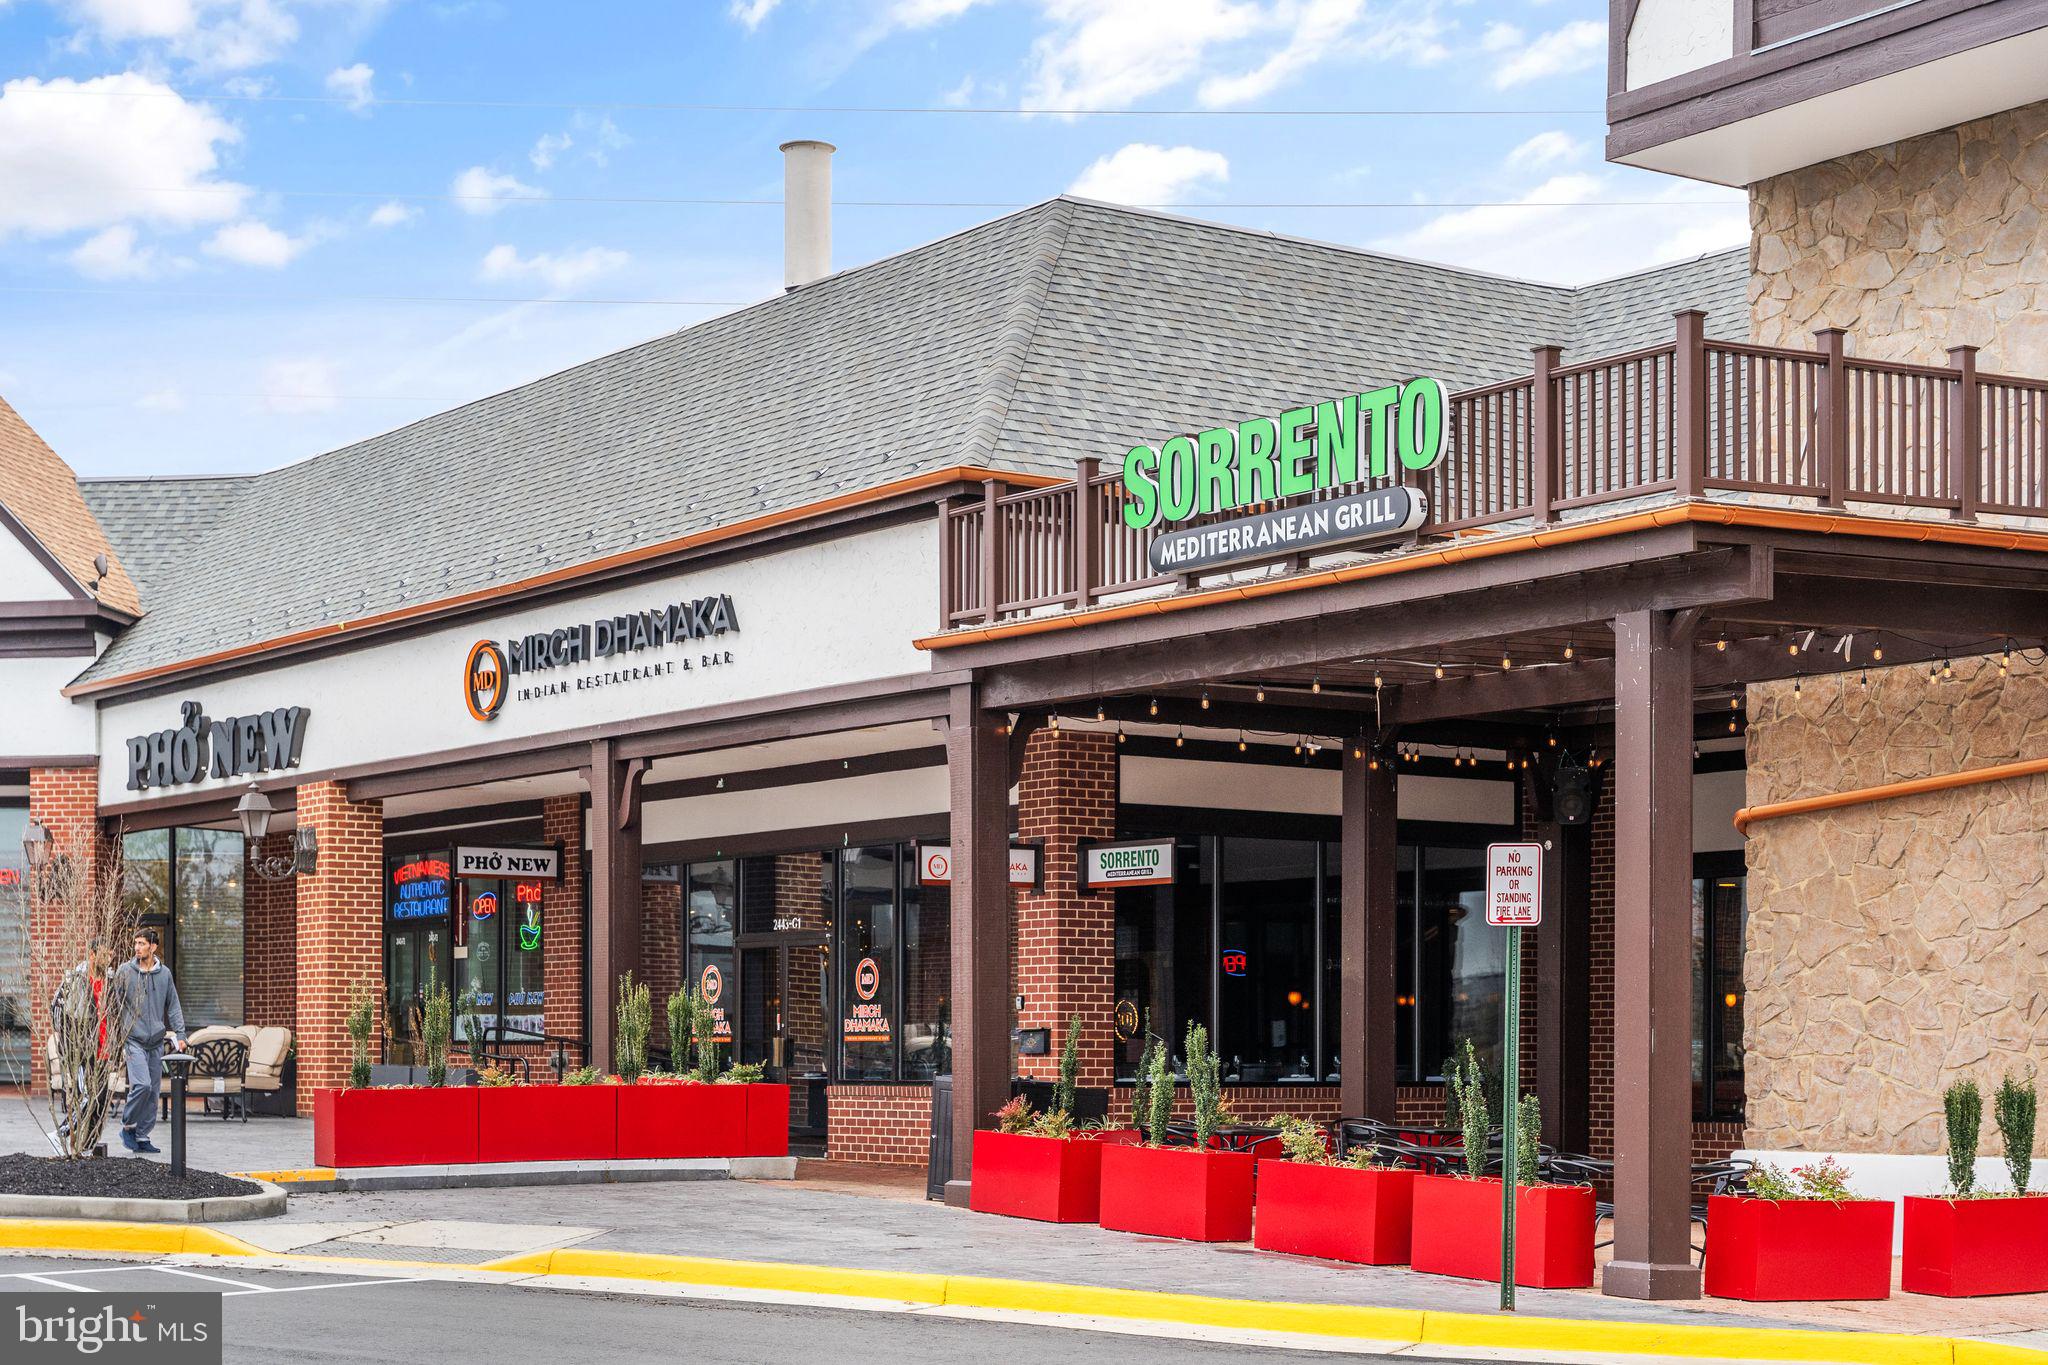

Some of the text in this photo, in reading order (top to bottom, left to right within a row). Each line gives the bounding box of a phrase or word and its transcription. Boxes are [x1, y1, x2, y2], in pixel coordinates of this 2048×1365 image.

[1123, 376, 1449, 530] SORRENTO
[1160, 495, 1397, 566] MEDITERRANEAN GRILL
[508, 593, 740, 675] MIRCH DHAMAKA
[473, 669, 495, 691] MD
[518, 651, 734, 702] INDIAN RESTAURANT & BAR
[210, 706, 311, 779] NEW
[507, 858, 551, 872] NEW
[1100, 848, 1160, 870] SORRENTO
[1508, 852, 1521, 863] NO
[393, 860, 450, 885] VIETNAMESE
[1496, 866, 1533, 876] PARKING
[400, 879, 446, 899] AUTHENTIC
[1508, 879, 1520, 890] OR
[393, 896, 450, 919] RESTAURANT
[472, 897, 497, 915] OPEN
[1496, 892, 1532, 903] STANDING
[1496, 906, 1531, 916] FIRE LANE
[852, 1004, 882, 1018] MIRCH
[844, 1018, 890, 1032] DHAMAKA
